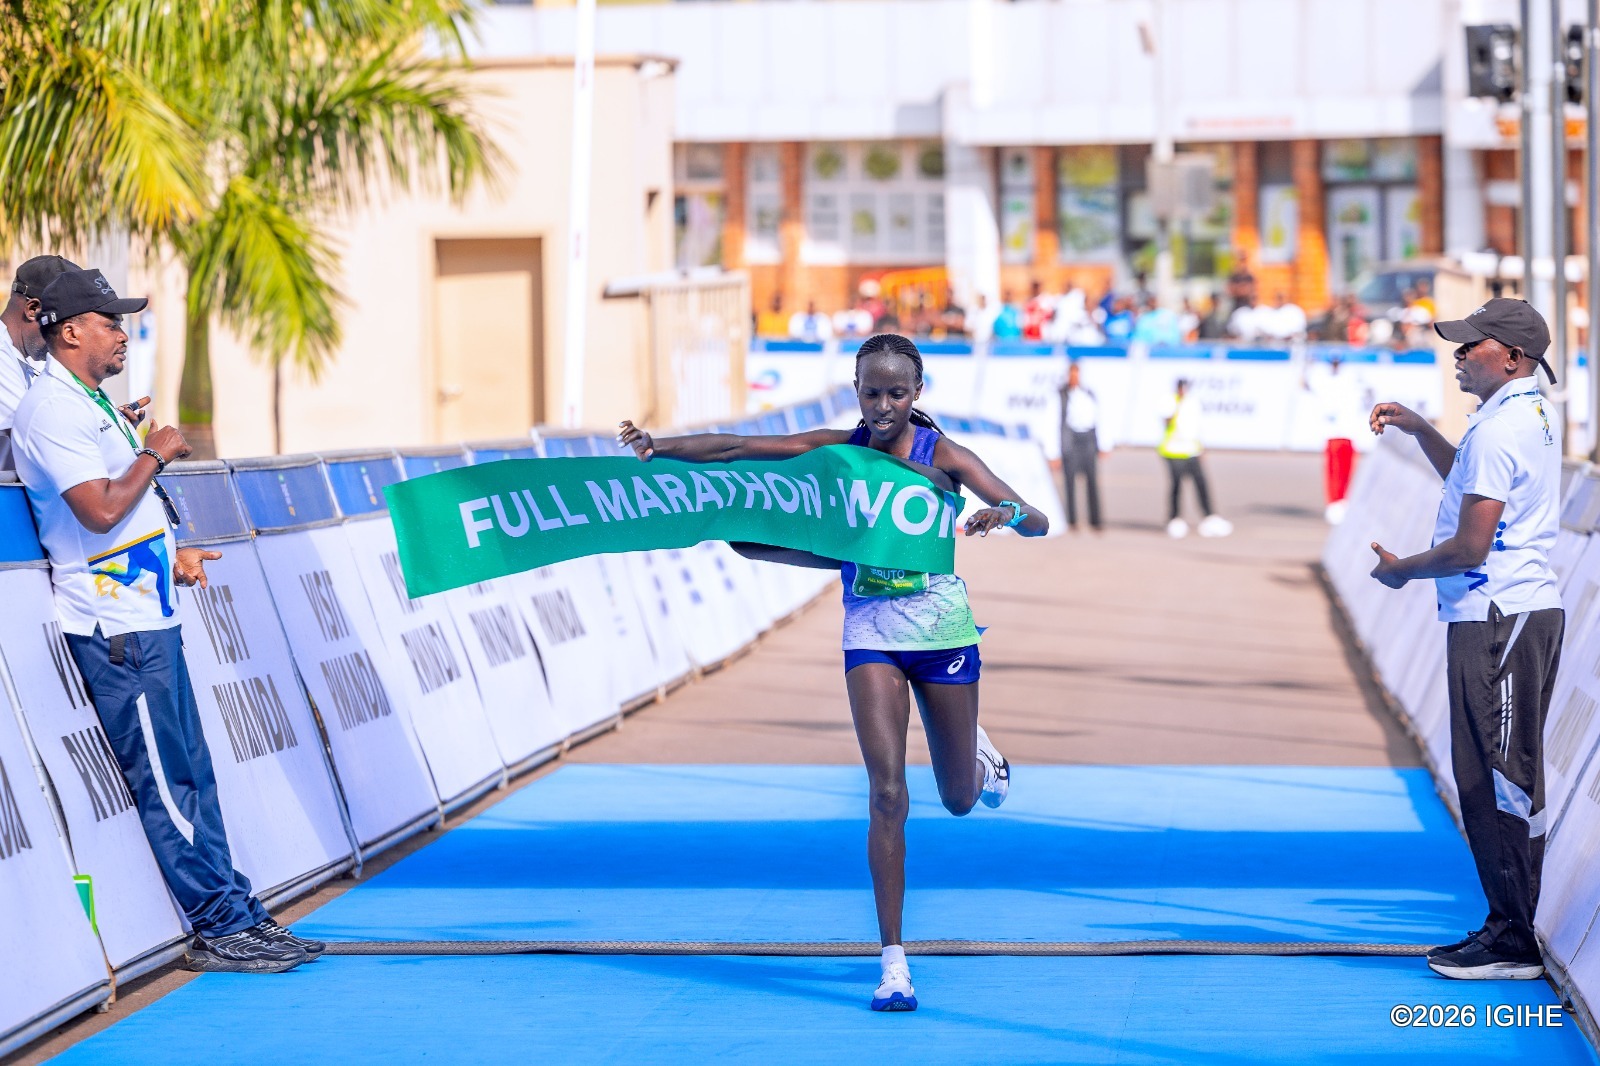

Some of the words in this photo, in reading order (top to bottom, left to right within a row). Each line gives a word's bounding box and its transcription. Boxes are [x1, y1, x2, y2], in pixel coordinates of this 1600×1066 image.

[459, 485, 590, 549] FULL
[585, 470, 822, 523] MARATHON
[191, 585, 250, 665] VISIT
[299, 570, 351, 642] VISIT
[211, 673, 299, 764] RWANDA
[320, 648, 392, 732] RWANDA
